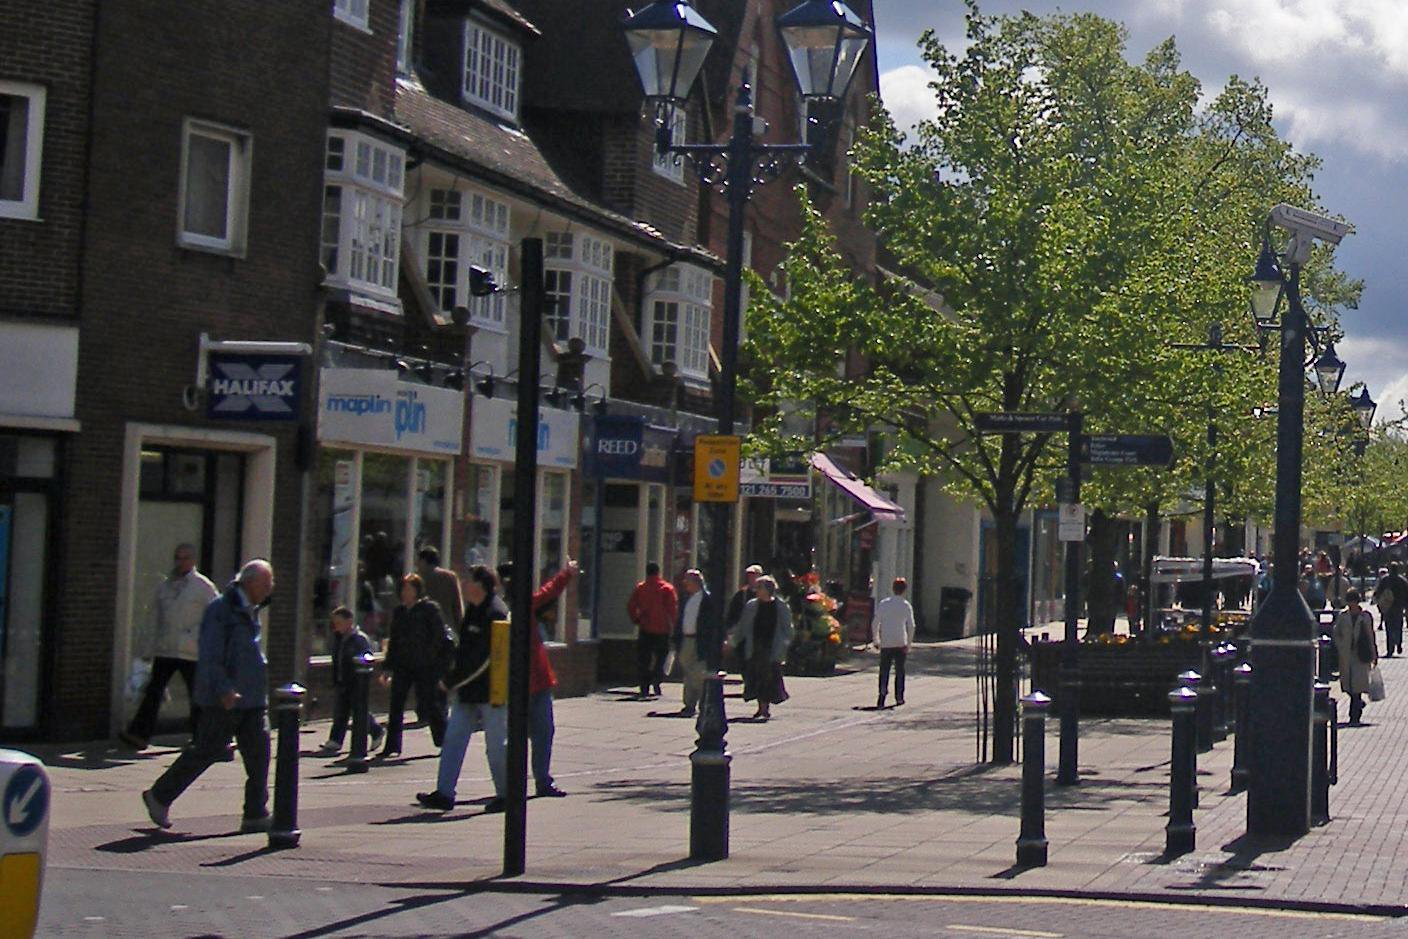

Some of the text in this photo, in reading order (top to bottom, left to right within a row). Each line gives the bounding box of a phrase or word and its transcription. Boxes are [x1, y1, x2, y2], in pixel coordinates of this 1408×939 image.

[213, 378, 295, 397] HALIFAX
[326, 393, 392, 417] maplin
[395, 391, 426, 441] plin
[598, 439, 638, 455] REED
[740, 484, 806, 497] 121 265 7500
